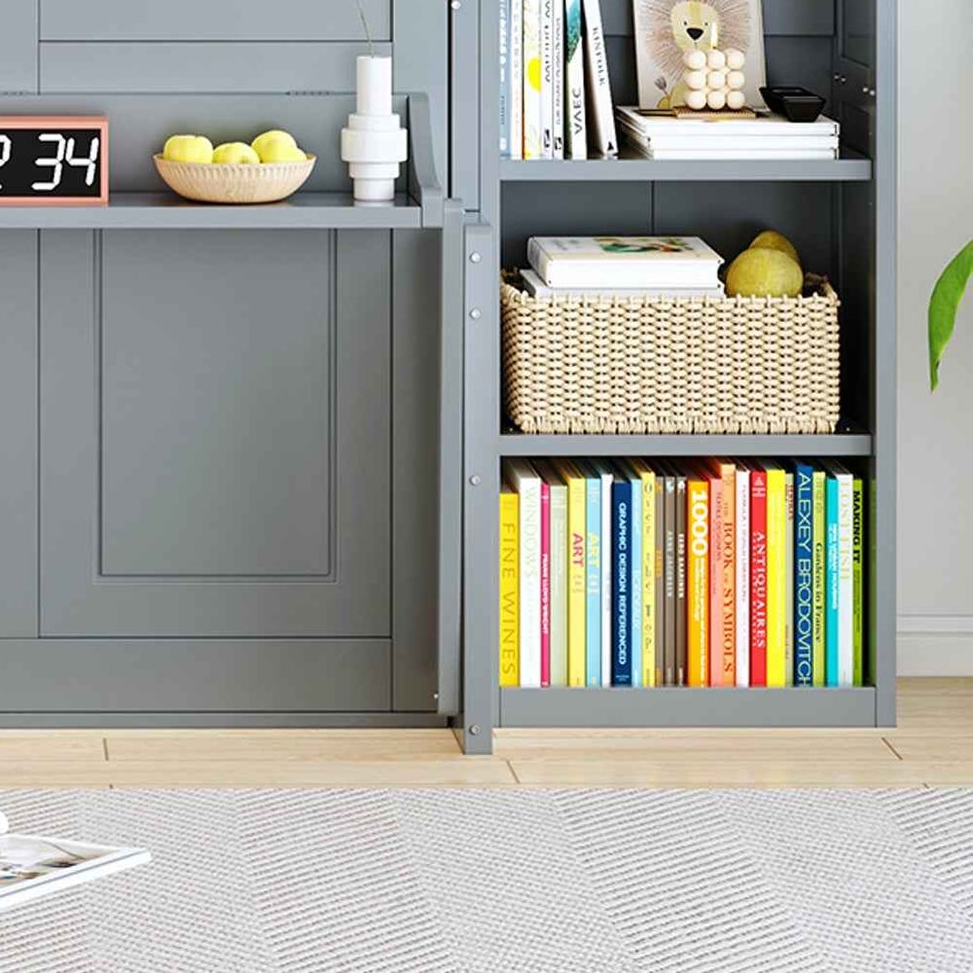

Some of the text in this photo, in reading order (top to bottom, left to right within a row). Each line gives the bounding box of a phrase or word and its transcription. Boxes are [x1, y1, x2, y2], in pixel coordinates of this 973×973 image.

[31, 133, 99, 191] 34
[692, 490, 708, 556] 1000
[722, 521, 733, 569] BOOK
[797, 472, 811, 553] ALEXEY
[853, 490, 861, 547] MAKING
[572, 532, 584, 568] ART
[587, 531, 600, 568] ART
[853, 549, 861, 564] IT
[502, 522, 516, 676] FINE WINES
[617, 502, 627, 665] GRAPHIC DESIGN REFERENCED
[756, 530, 766, 648] ANTIQUAIRES
[815, 542, 823, 643] Gardens in France
[722, 587, 733, 673] SYMBOLS
